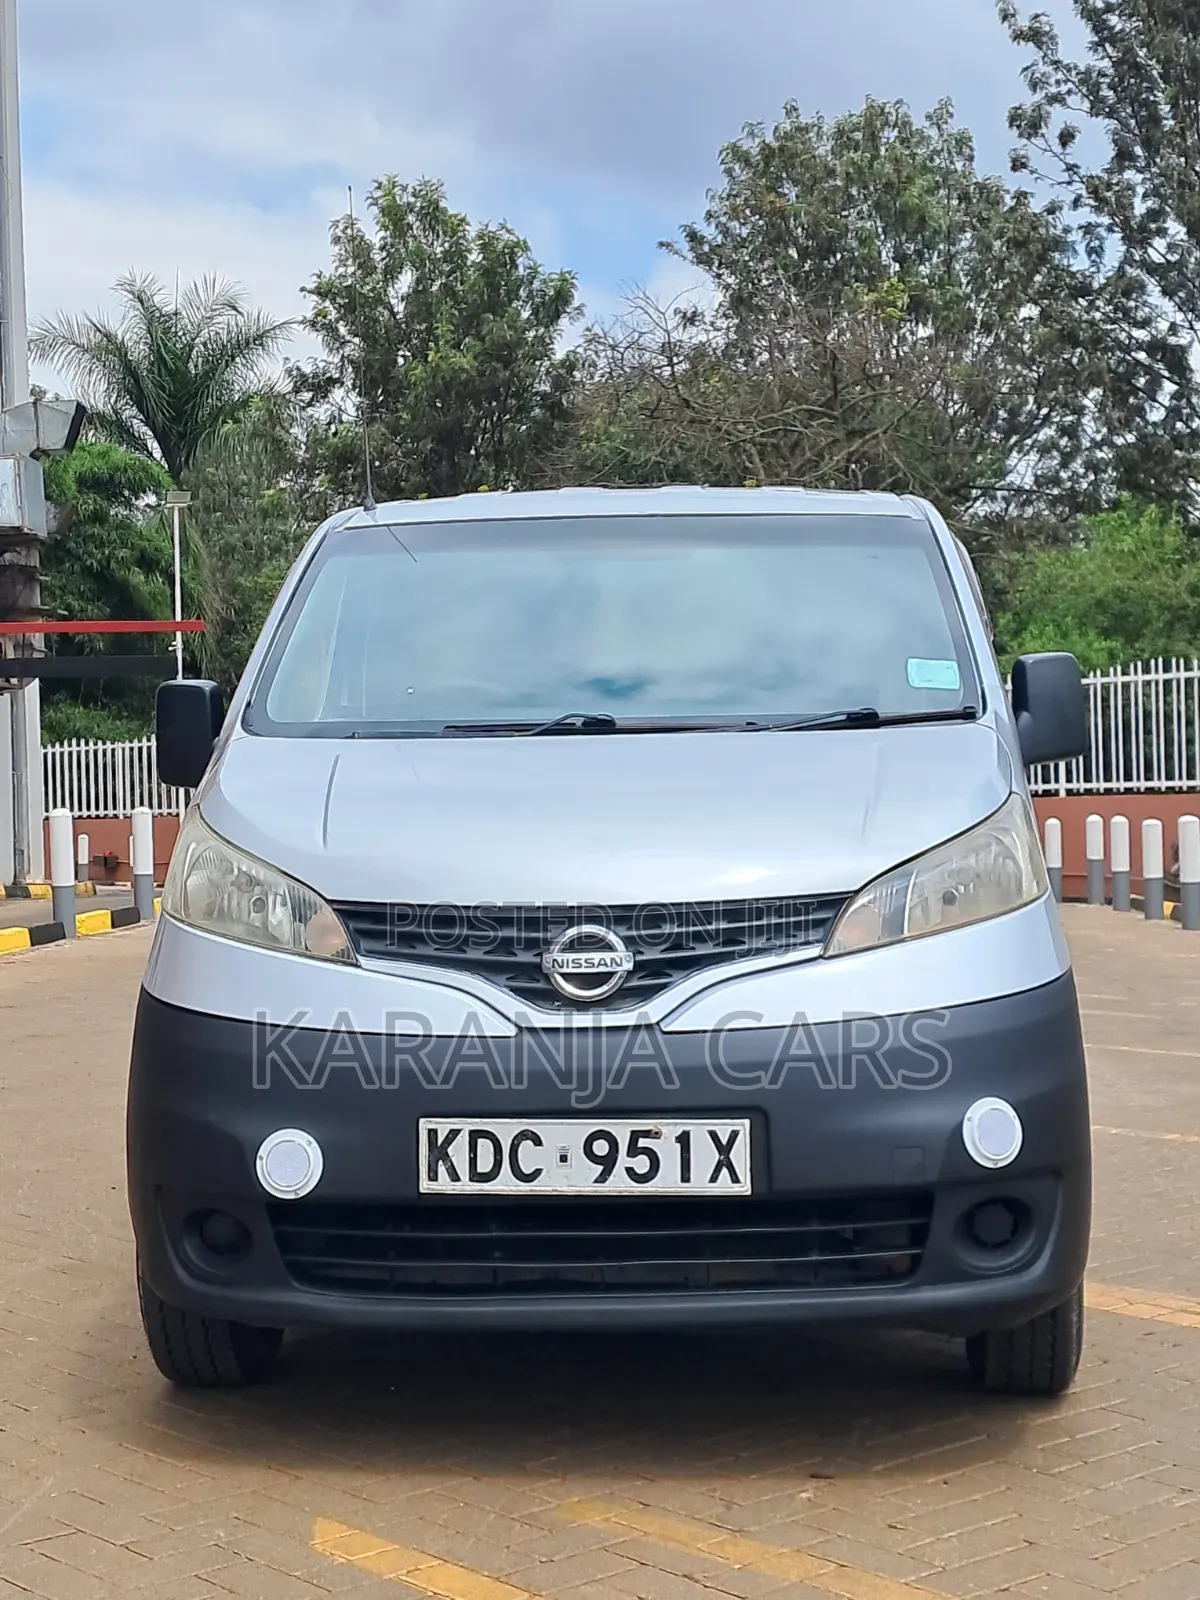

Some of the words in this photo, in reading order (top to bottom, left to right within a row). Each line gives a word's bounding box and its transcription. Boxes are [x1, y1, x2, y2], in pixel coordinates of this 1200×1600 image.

[551, 957, 624, 969] NISSAN
[427, 1128, 544, 1184] KDC
[583, 1128, 743, 1185] 951X
